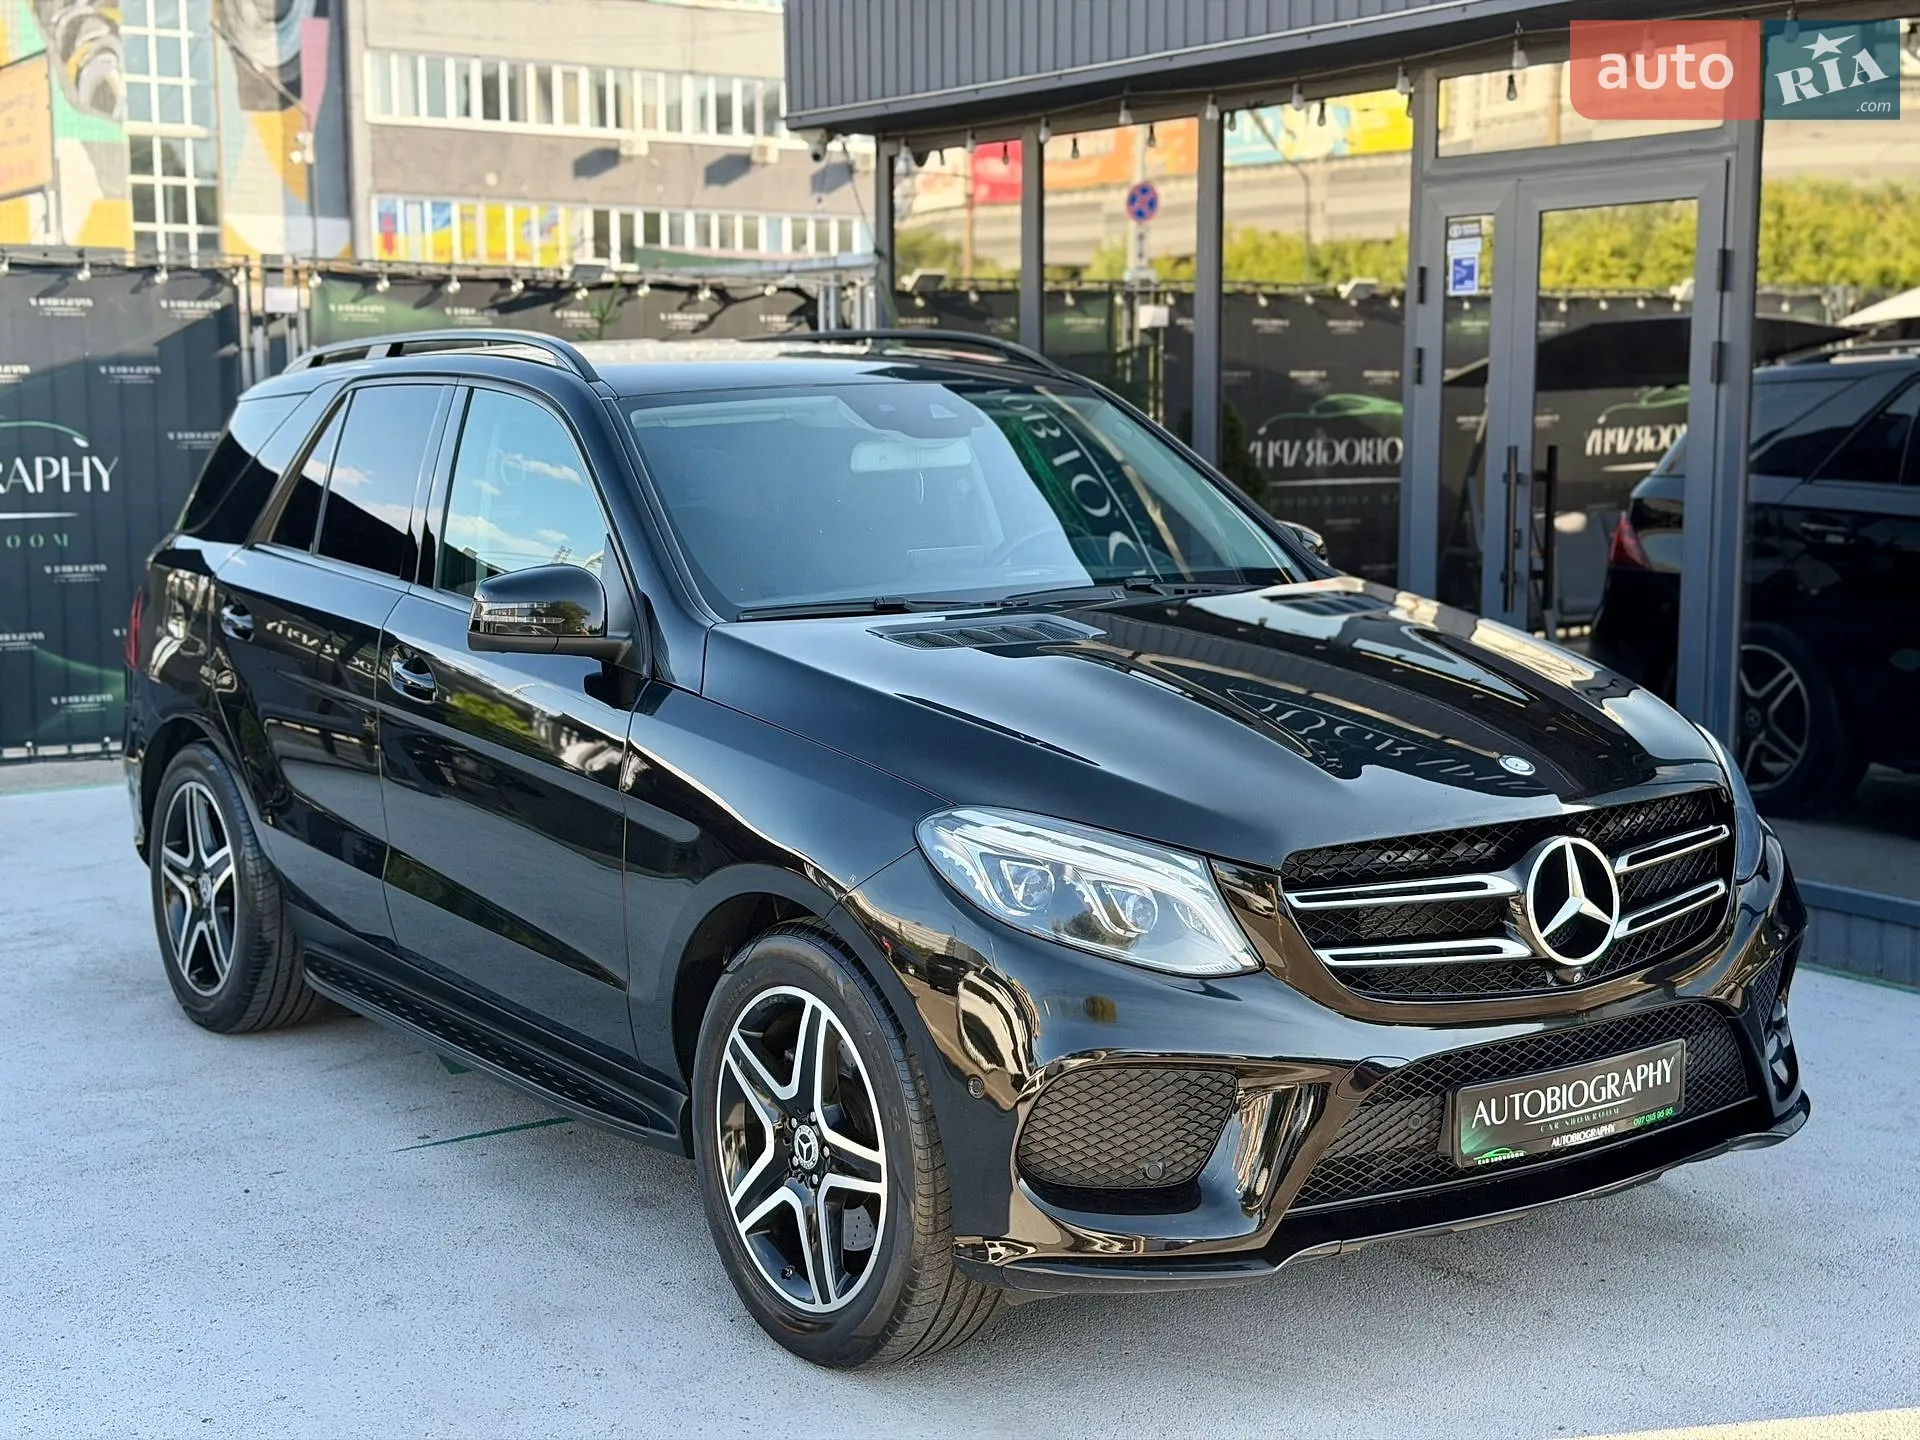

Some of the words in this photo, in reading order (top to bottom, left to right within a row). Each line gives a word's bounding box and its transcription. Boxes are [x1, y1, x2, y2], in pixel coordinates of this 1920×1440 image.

[1471, 1056, 1676, 1129] AUTOBIOGRAPHY
[1540, 1122, 1559, 1133] CAR
[1564, 1107, 1620, 1126] SHOWROOM
[1551, 1123, 1617, 1148] AUTOBIOGRAPHY
